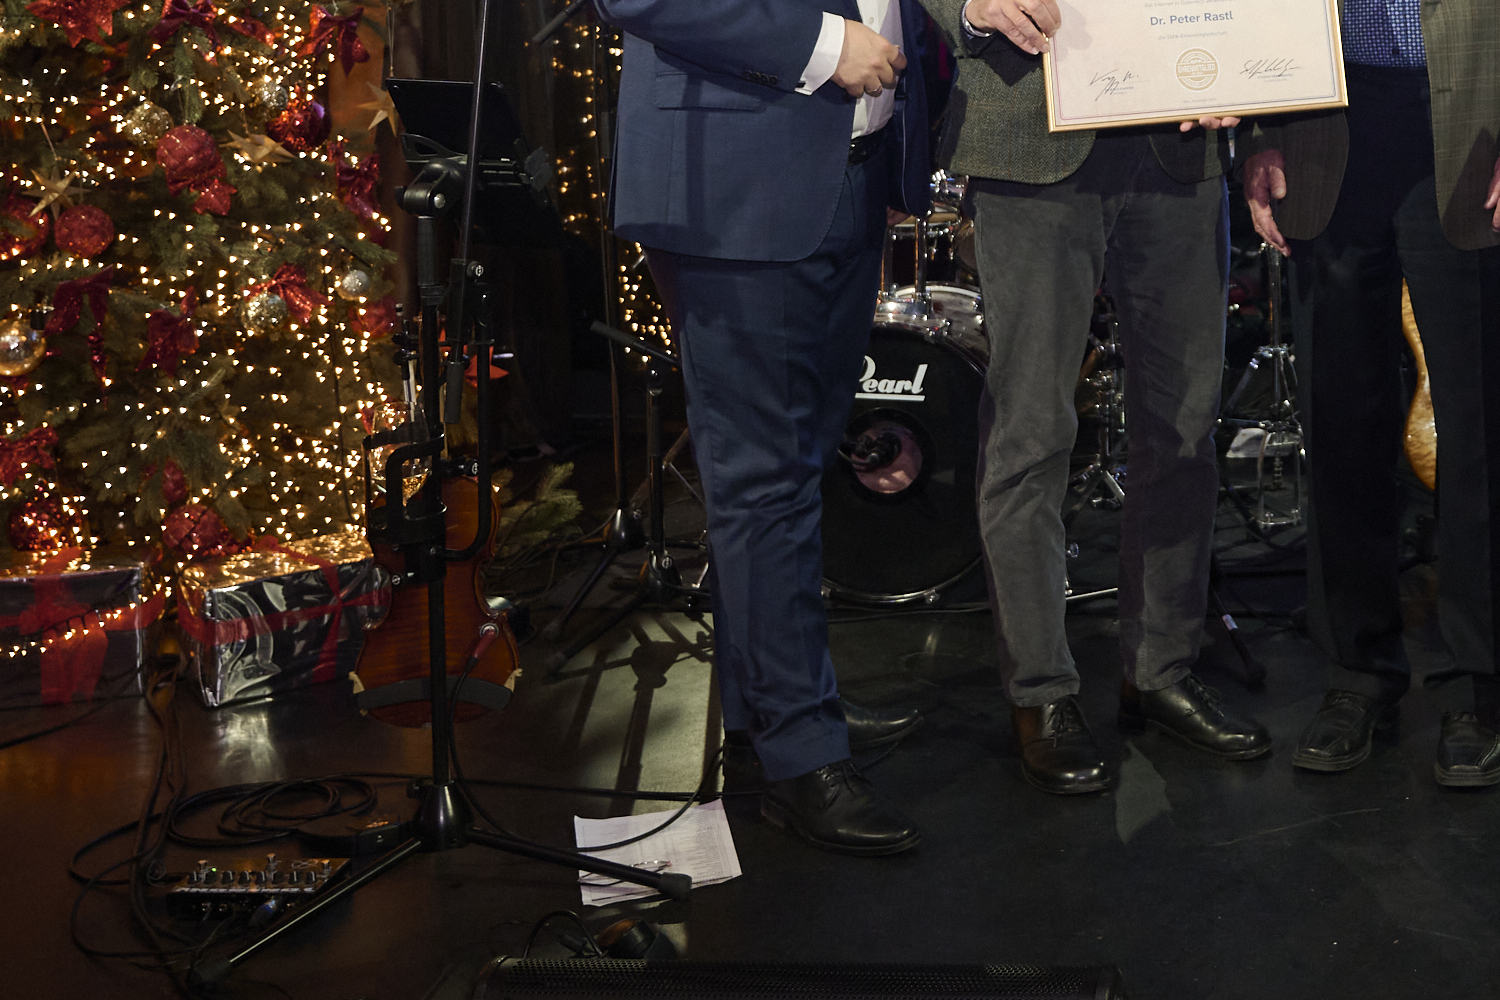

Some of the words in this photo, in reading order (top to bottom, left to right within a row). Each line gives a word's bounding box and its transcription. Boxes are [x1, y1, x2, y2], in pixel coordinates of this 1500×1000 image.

[1150, 16, 1166, 26] Dr.
[1170, 13, 1201, 24] Peter
[1204, 10, 1234, 22] Rastl
